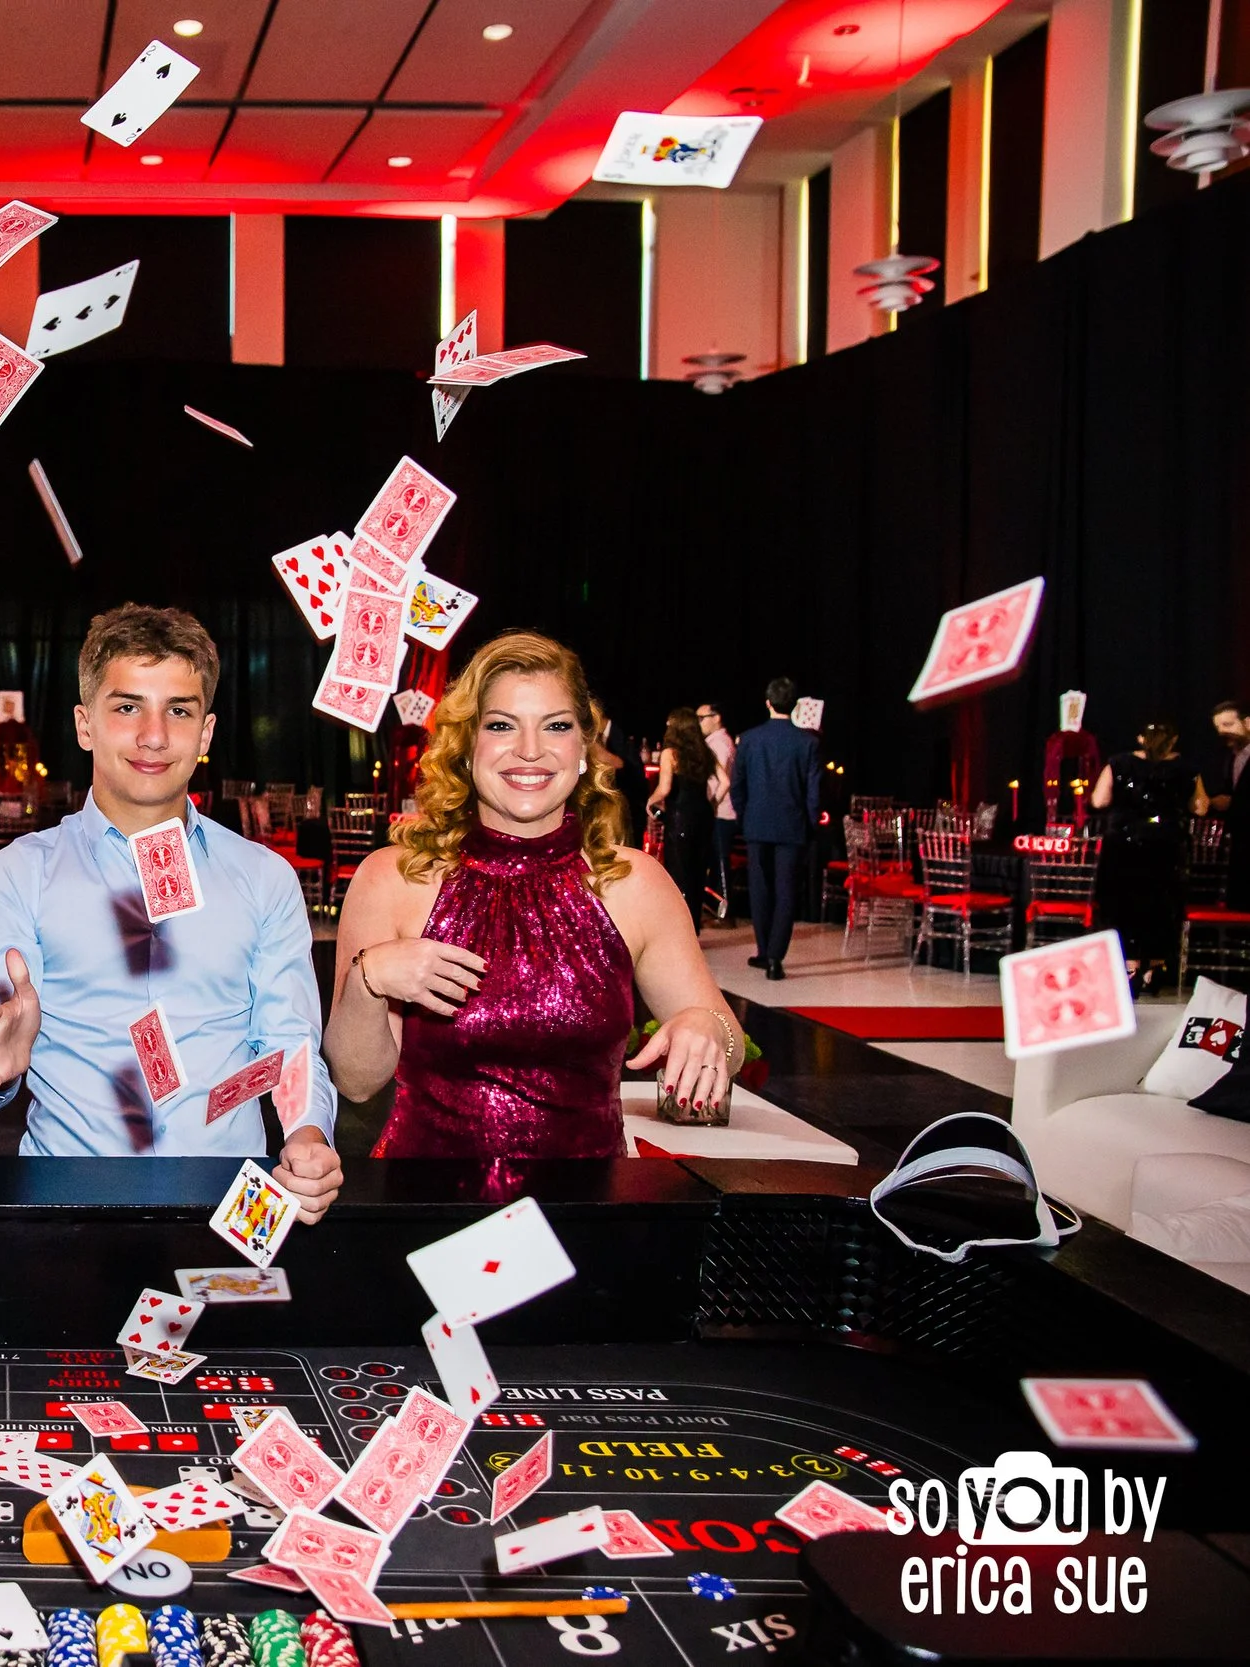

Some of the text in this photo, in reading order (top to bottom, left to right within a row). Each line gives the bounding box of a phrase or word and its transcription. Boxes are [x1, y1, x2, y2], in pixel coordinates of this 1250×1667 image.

[500, 1387, 670, 1401] PASS LINE
[28, 1424, 75, 1432] HORN
[557, 1414, 731, 1427] Don't Pass Bar
[578, 1441, 726, 1458] FIELD
[547, 1615, 623, 1657] 8
[709, 1612, 798, 1653] six
